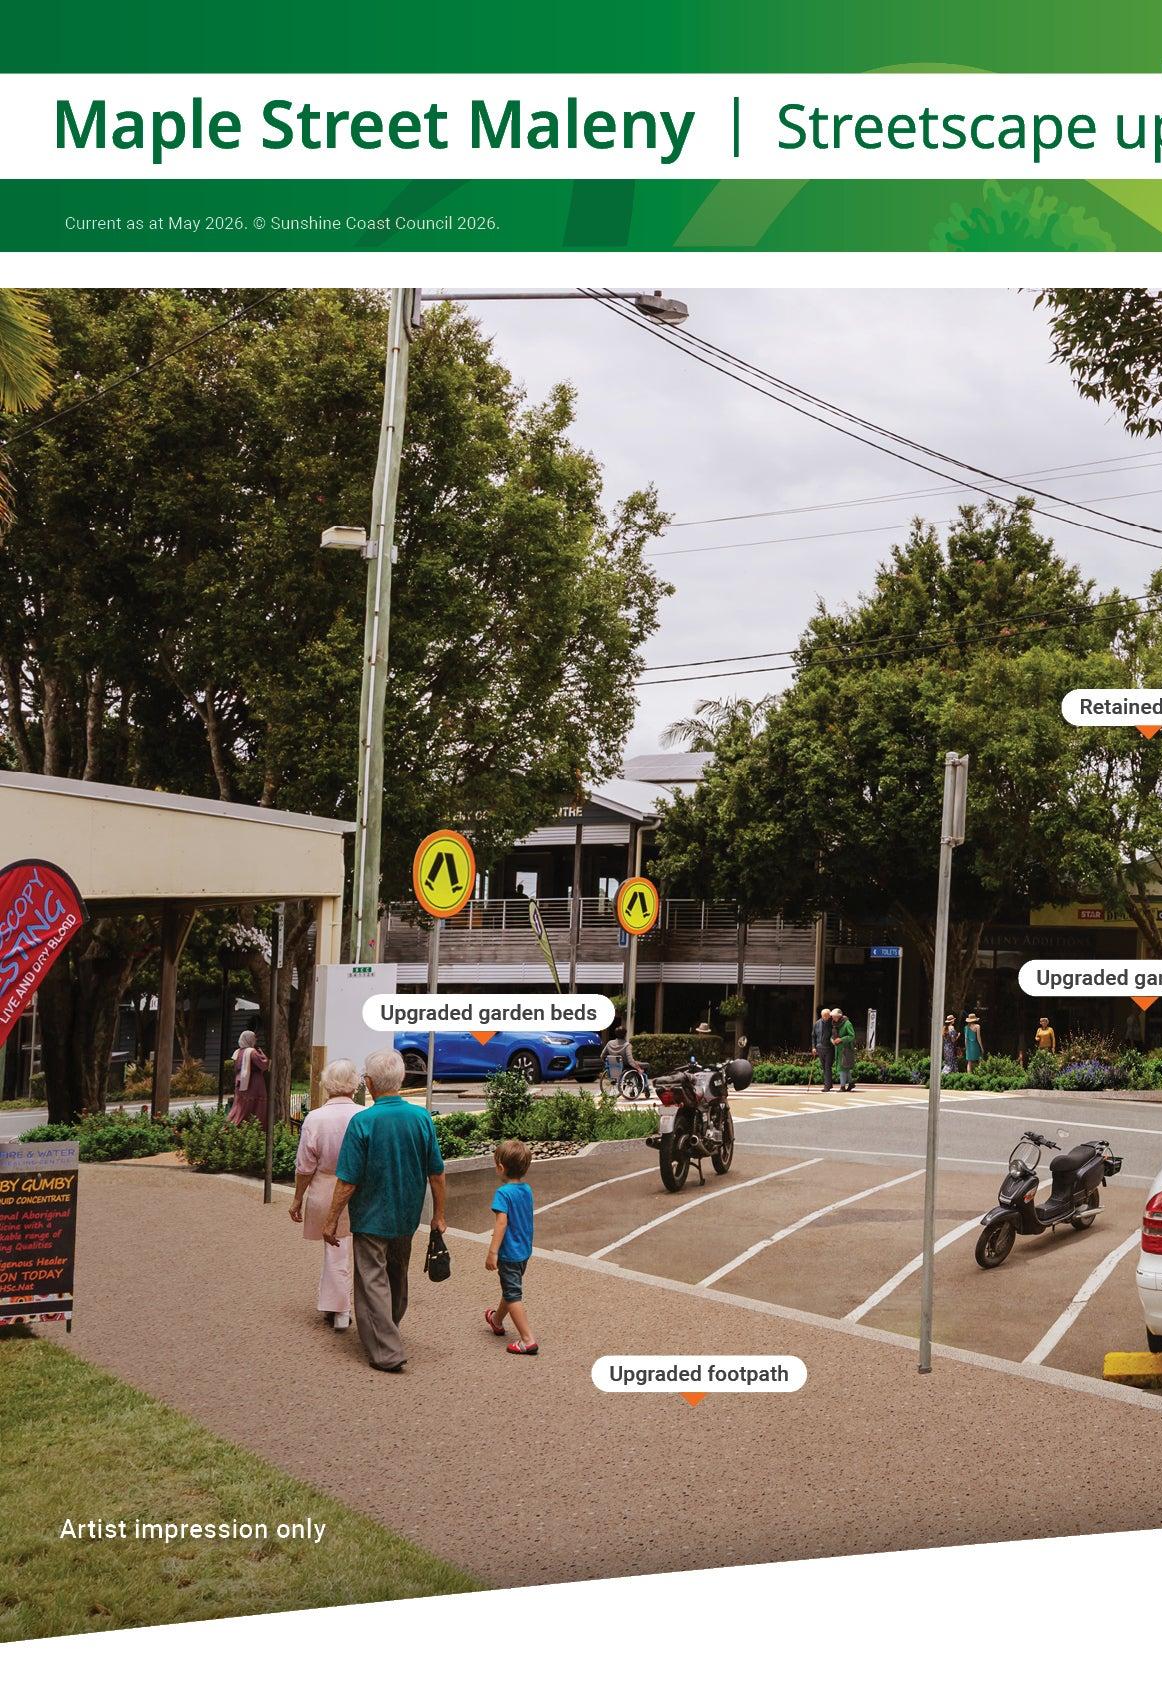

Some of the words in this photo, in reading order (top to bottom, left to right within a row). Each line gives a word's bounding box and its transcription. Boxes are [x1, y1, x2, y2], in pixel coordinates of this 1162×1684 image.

[1081, 910, 1101, 918] STAR
[1, 995, 21, 1024] LIVE
[16, 971, 36, 999] AND
[33, 948, 51, 974] DRY
[37, 1148, 76, 1158] WATER
[21, 1175, 75, 1193] GUMBY
[16, 1193, 71, 1205] CONCENTRATE
[22, 1208, 72, 1221] Aboriginal
[24, 1221, 44, 1230] with
[37, 1256, 69, 1267] Healer
[22, 1269, 65, 1281] TODAY
